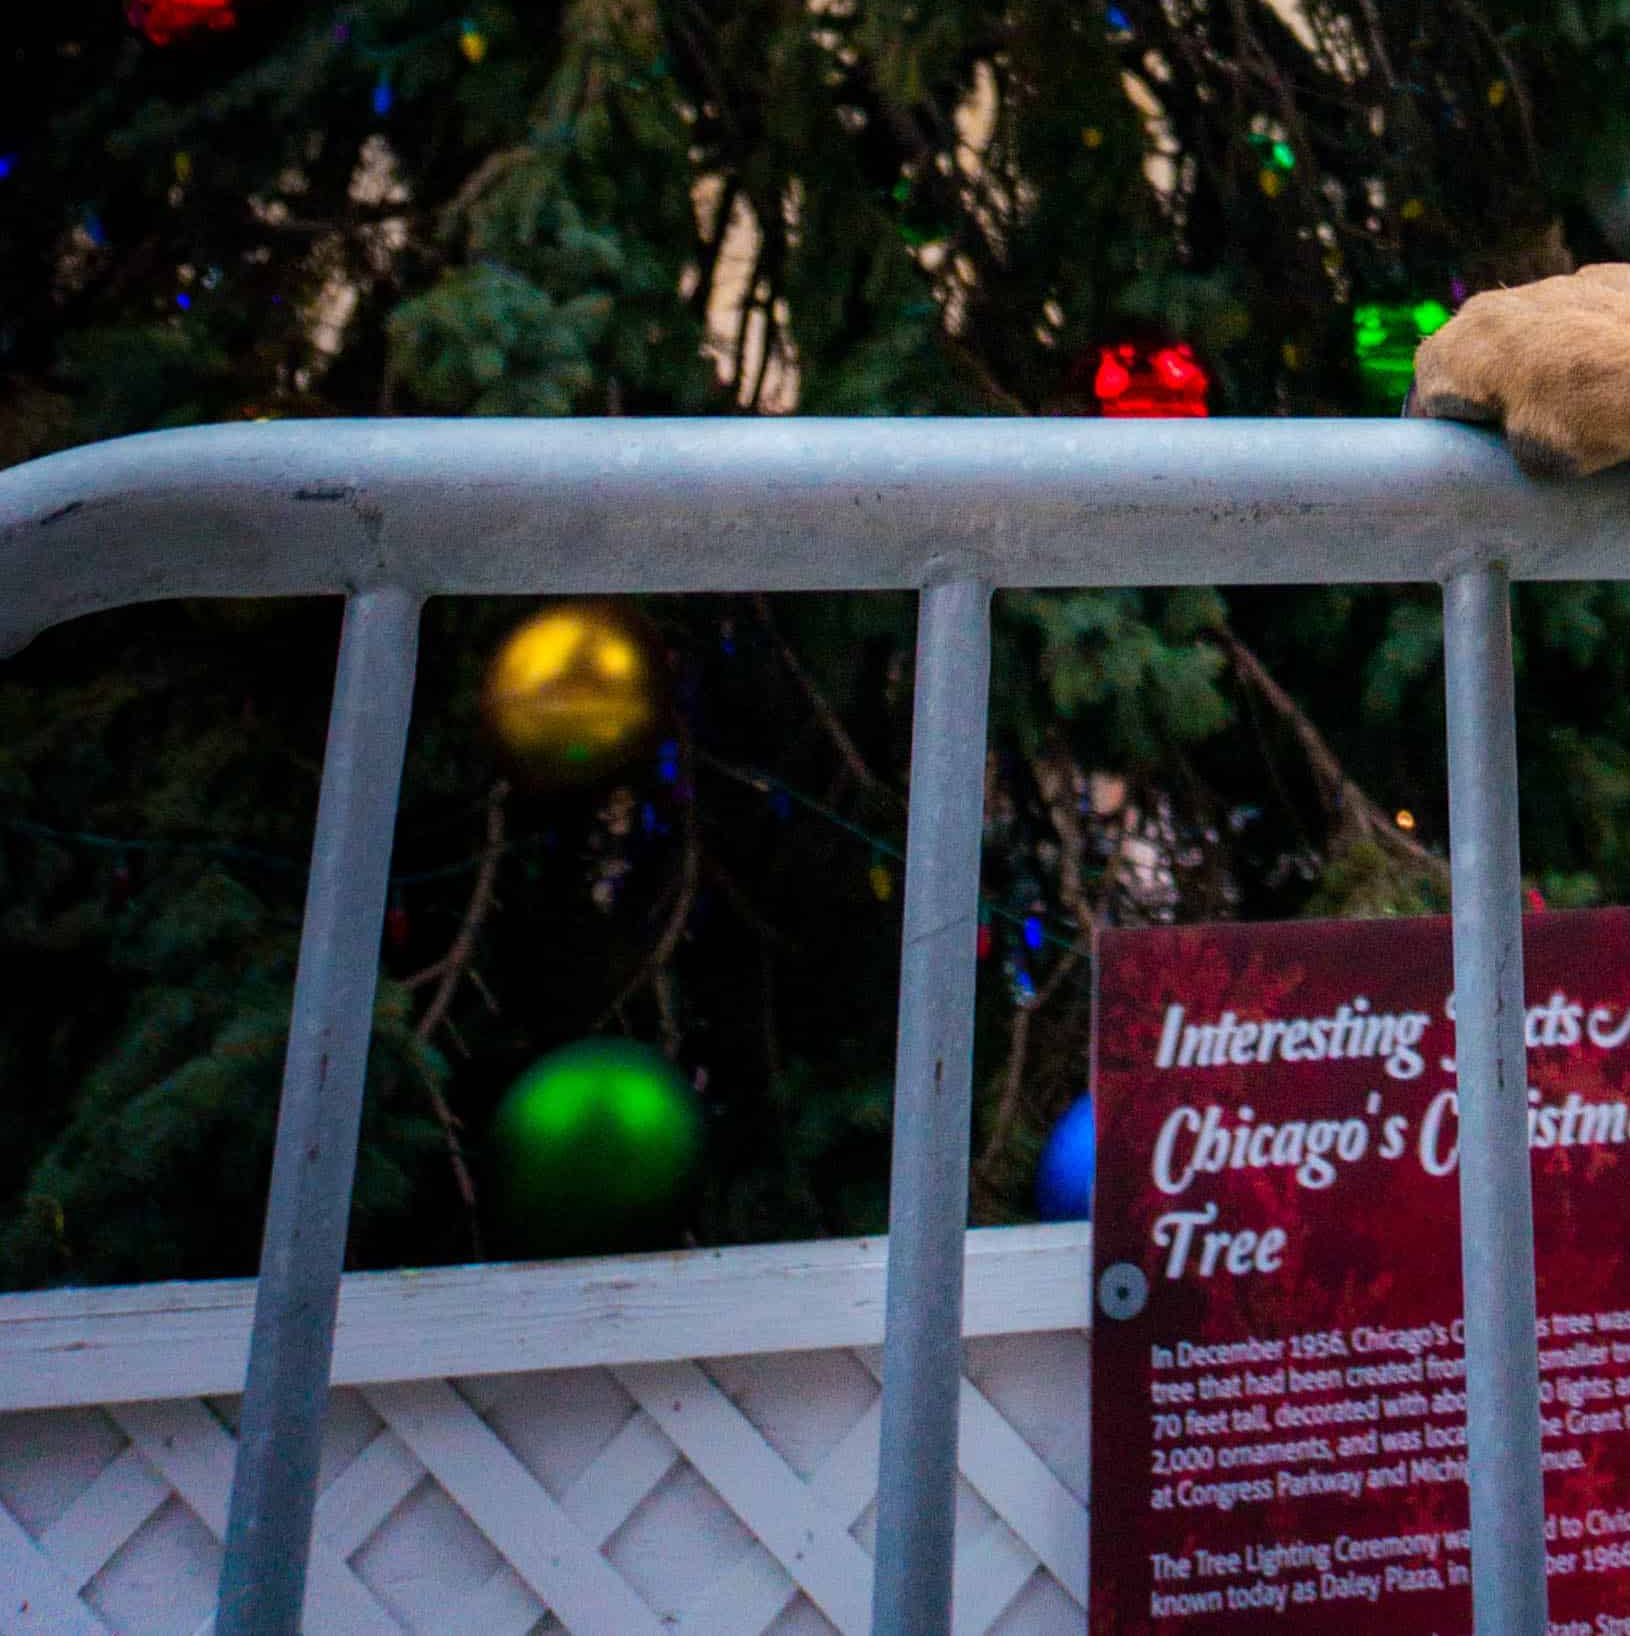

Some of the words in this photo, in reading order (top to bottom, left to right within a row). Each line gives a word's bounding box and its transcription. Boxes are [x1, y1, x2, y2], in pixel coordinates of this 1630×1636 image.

[1155, 995, 1431, 1080] Interesting
[1440, 994, 1583, 1073] cts
[1153, 1091, 1409, 1195] Chicago's
[1152, 1202, 1287, 1280] Tree
[1151, 1342, 1173, 1370] In
[1176, 1336, 1285, 1368] December
[1351, 1322, 1449, 1356] Chicago's
[1551, 1311, 1595, 1337] tree
[1151, 1379, 1196, 1405] tree
[1198, 1374, 1243, 1401] that
[1245, 1369, 1286, 1396] had
[1288, 1366, 1344, 1394] been
[1346, 1354, 1424, 1388] created
[1538, 1341, 1609, 1371] smaller
[1152, 1411, 1183, 1441] 70
[1184, 1408, 1229, 1435] feet
[1274, 1397, 1380, 1428] decorated
[1382, 1391, 1429, 1419] with
[1556, 1376, 1614, 1409] lights
[1152, 1445, 1215, 1475] 2,000
[1336, 1429, 1379, 1458] and
[1380, 1430, 1423, 1453] was
[1565, 1409, 1624, 1436] Grant
[1151, 1485, 1175, 1510] at
[1176, 1478, 1275, 1512] Congress
[1277, 1469, 1364, 1499] Parkway
[1366, 1460, 1408, 1489] and
[1152, 1552, 1191, 1581] The
[1193, 1548, 1242, 1577] Tree
[1245, 1539, 1332, 1578] Lighting
[1334, 1532, 1442, 1562] Ceremony
[1559, 1513, 1584, 1540] to
[1151, 1588, 1223, 1620] known
[1225, 1579, 1289, 1612] today
[1291, 1578, 1318, 1605] as
[1320, 1570, 1382, 1603] Daley
